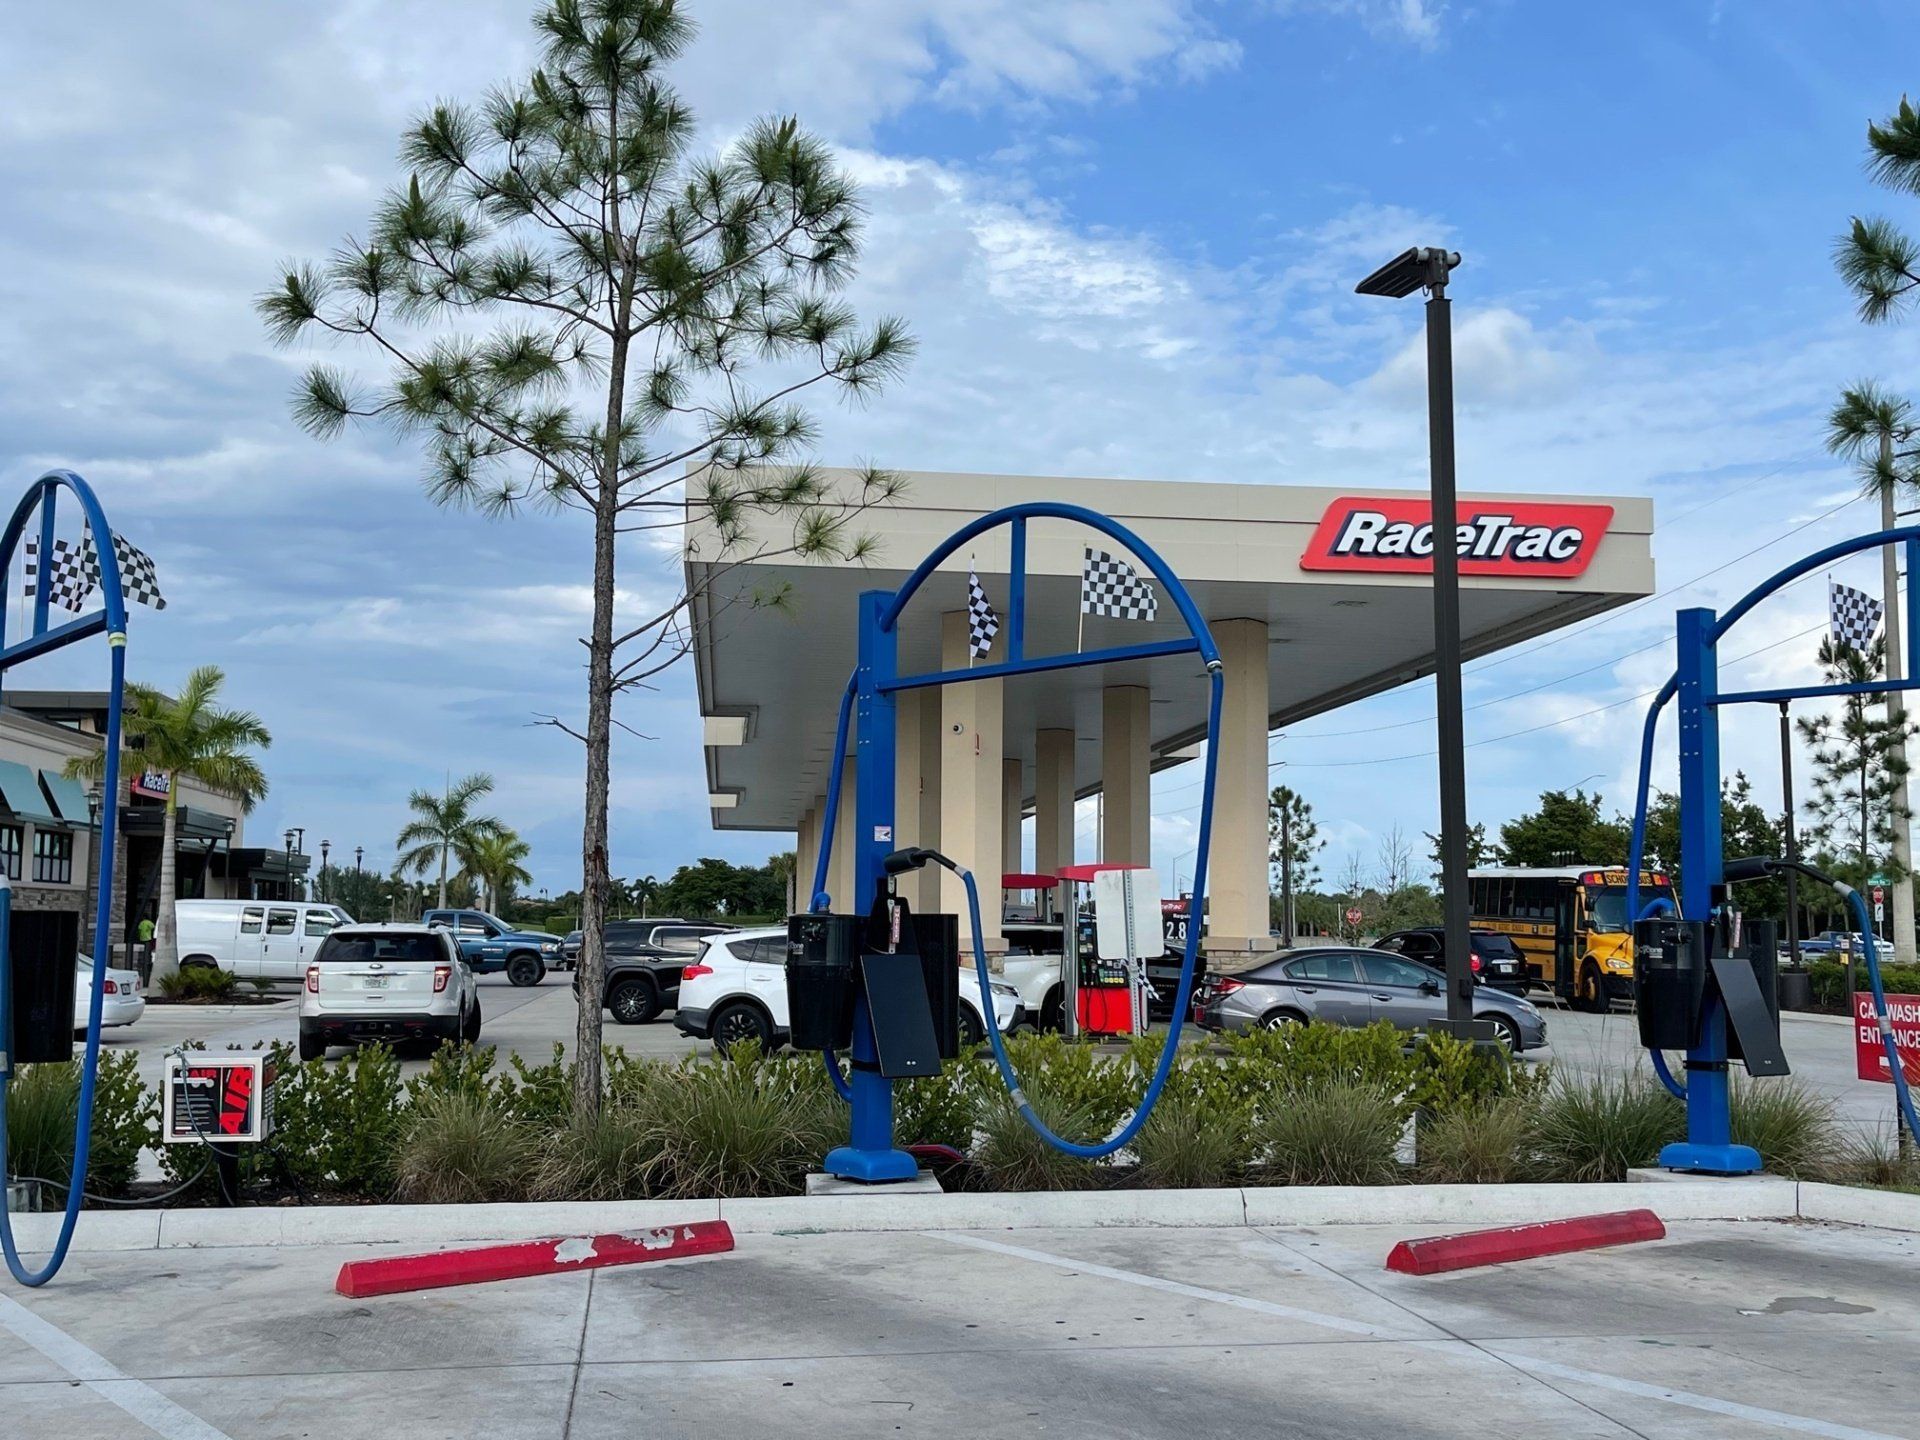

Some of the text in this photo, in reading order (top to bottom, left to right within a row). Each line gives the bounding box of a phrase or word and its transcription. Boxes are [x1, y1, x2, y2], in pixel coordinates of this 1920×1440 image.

[1333, 510, 1583, 560] RaceTrac
[144, 770, 171, 792] RaceTra
[1606, 874, 1630, 884] SCHO
[1166, 921, 1187, 940] 2.8
[1859, 1001, 1920, 1023] CA WASH
[1859, 1025, 1920, 1049] ENTANCE
